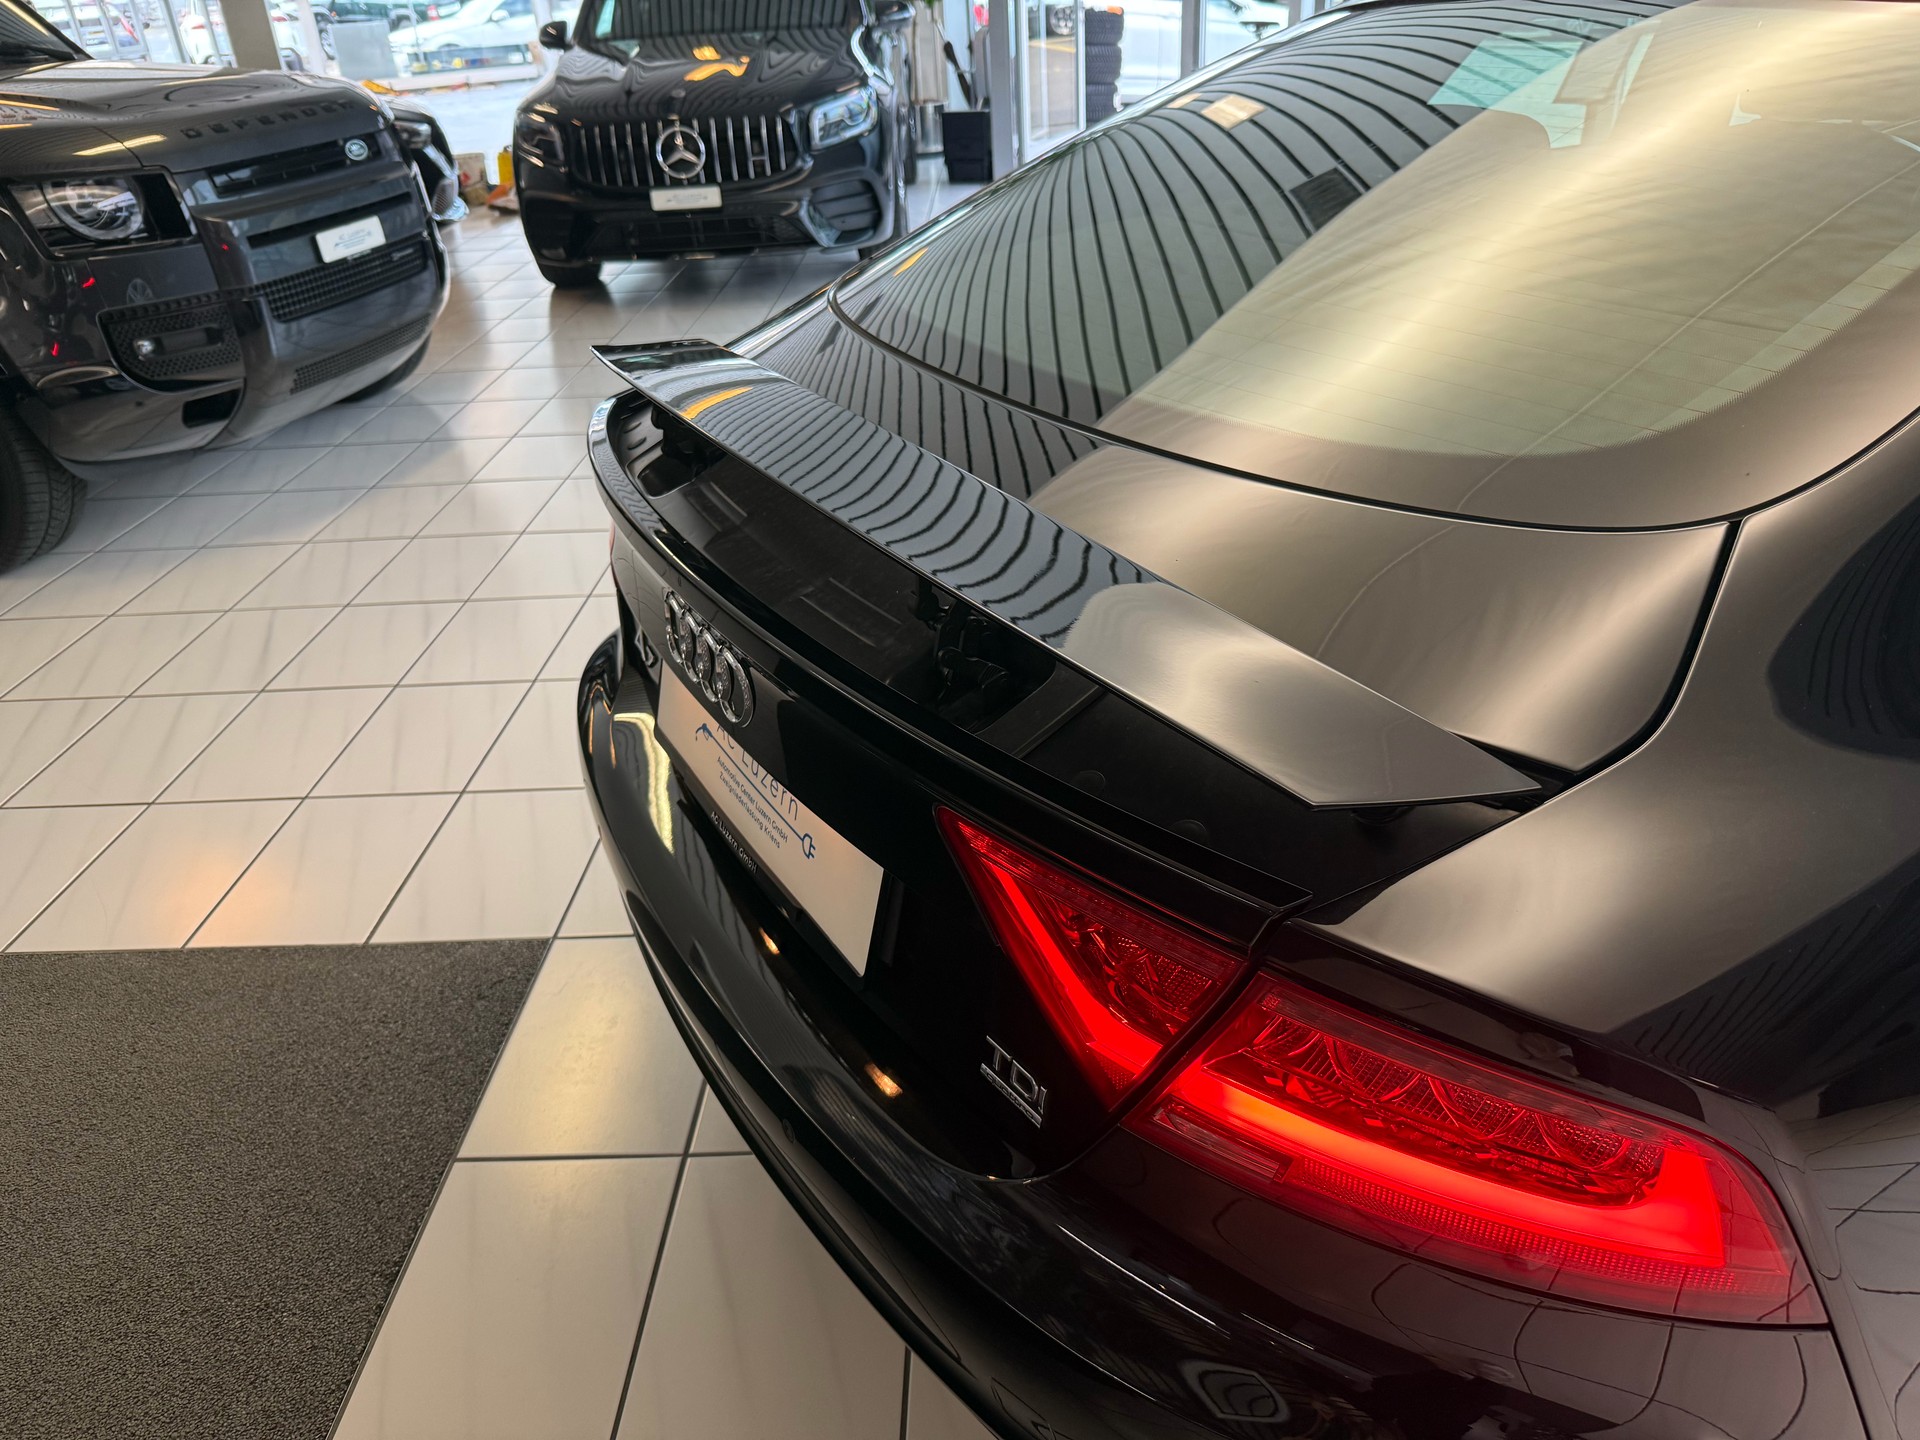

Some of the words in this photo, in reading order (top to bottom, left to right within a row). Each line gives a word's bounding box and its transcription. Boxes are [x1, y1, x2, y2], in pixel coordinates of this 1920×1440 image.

[180, 100, 354, 139] DEFENDER
[741, 750, 799, 821] Luzern
[755, 801, 773, 823] Luzern
[771, 820, 789, 844] GmbH
[764, 825, 781, 849] Kriens
[738, 847, 758, 873] GmbH
[985, 1035, 1048, 1115] TDI
